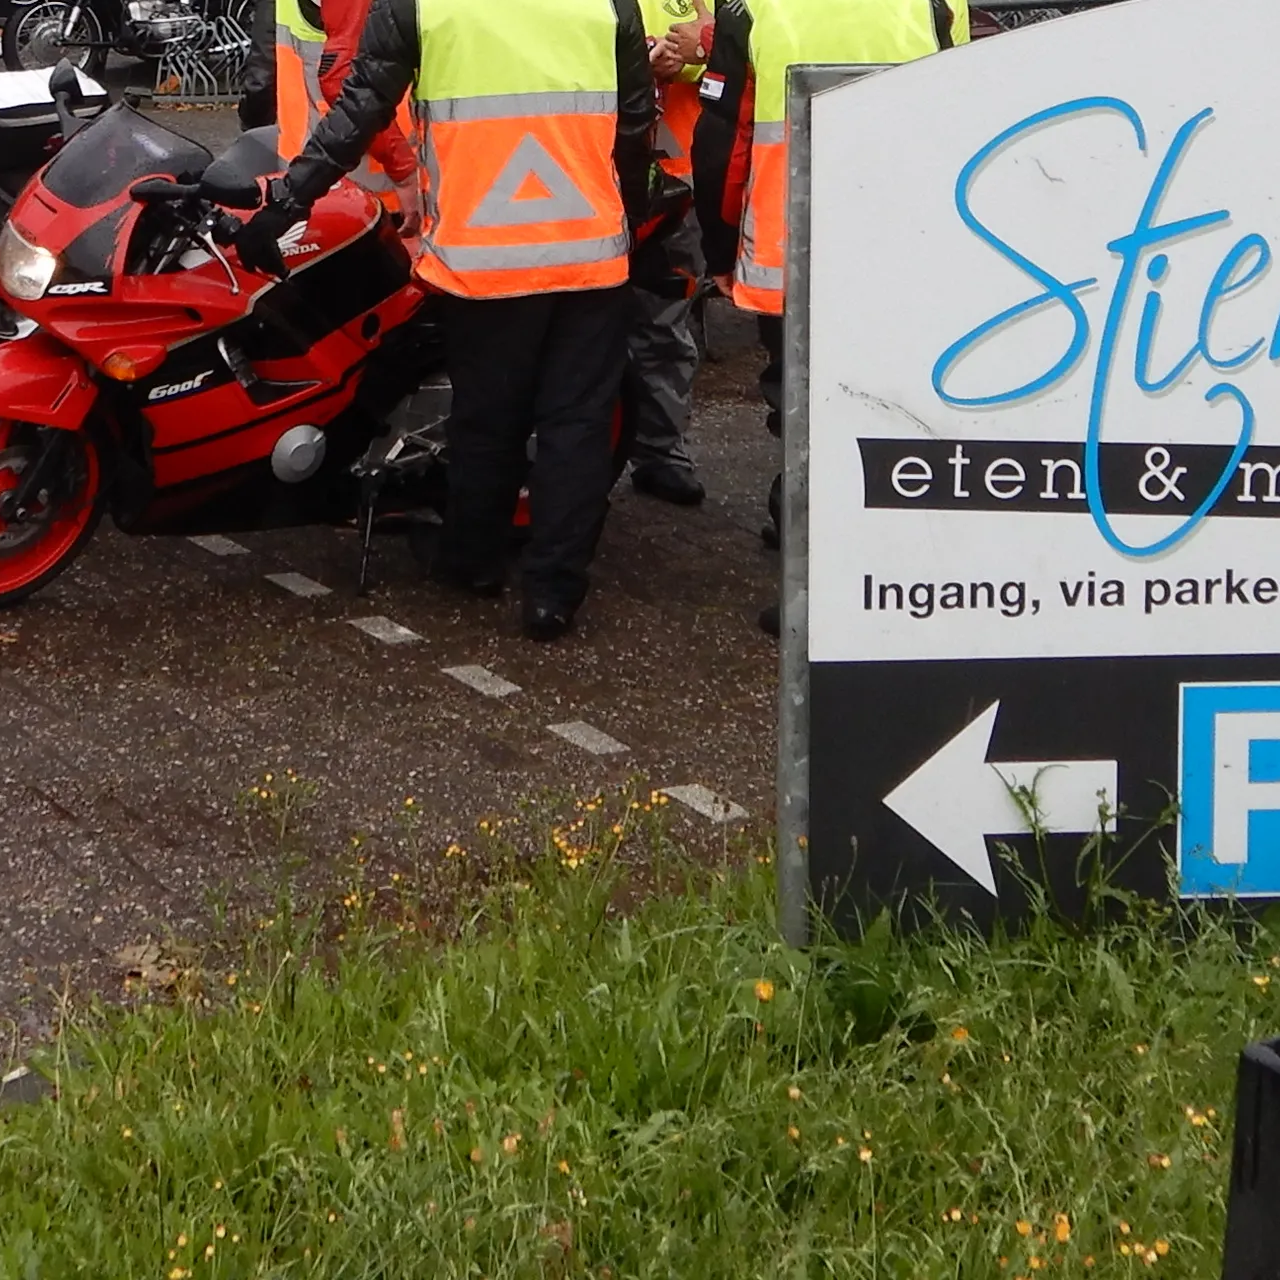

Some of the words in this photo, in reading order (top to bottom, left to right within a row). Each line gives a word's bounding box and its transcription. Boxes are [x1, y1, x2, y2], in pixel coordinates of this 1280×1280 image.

[280, 242, 321, 258] ONDA
[48, 281, 108, 296] CBR
[891, 444, 1086, 500] eten
[1137, 446, 1187, 502] &
[862, 574, 1041, 619] Ingang,
[1058, 570, 1125, 608] via
